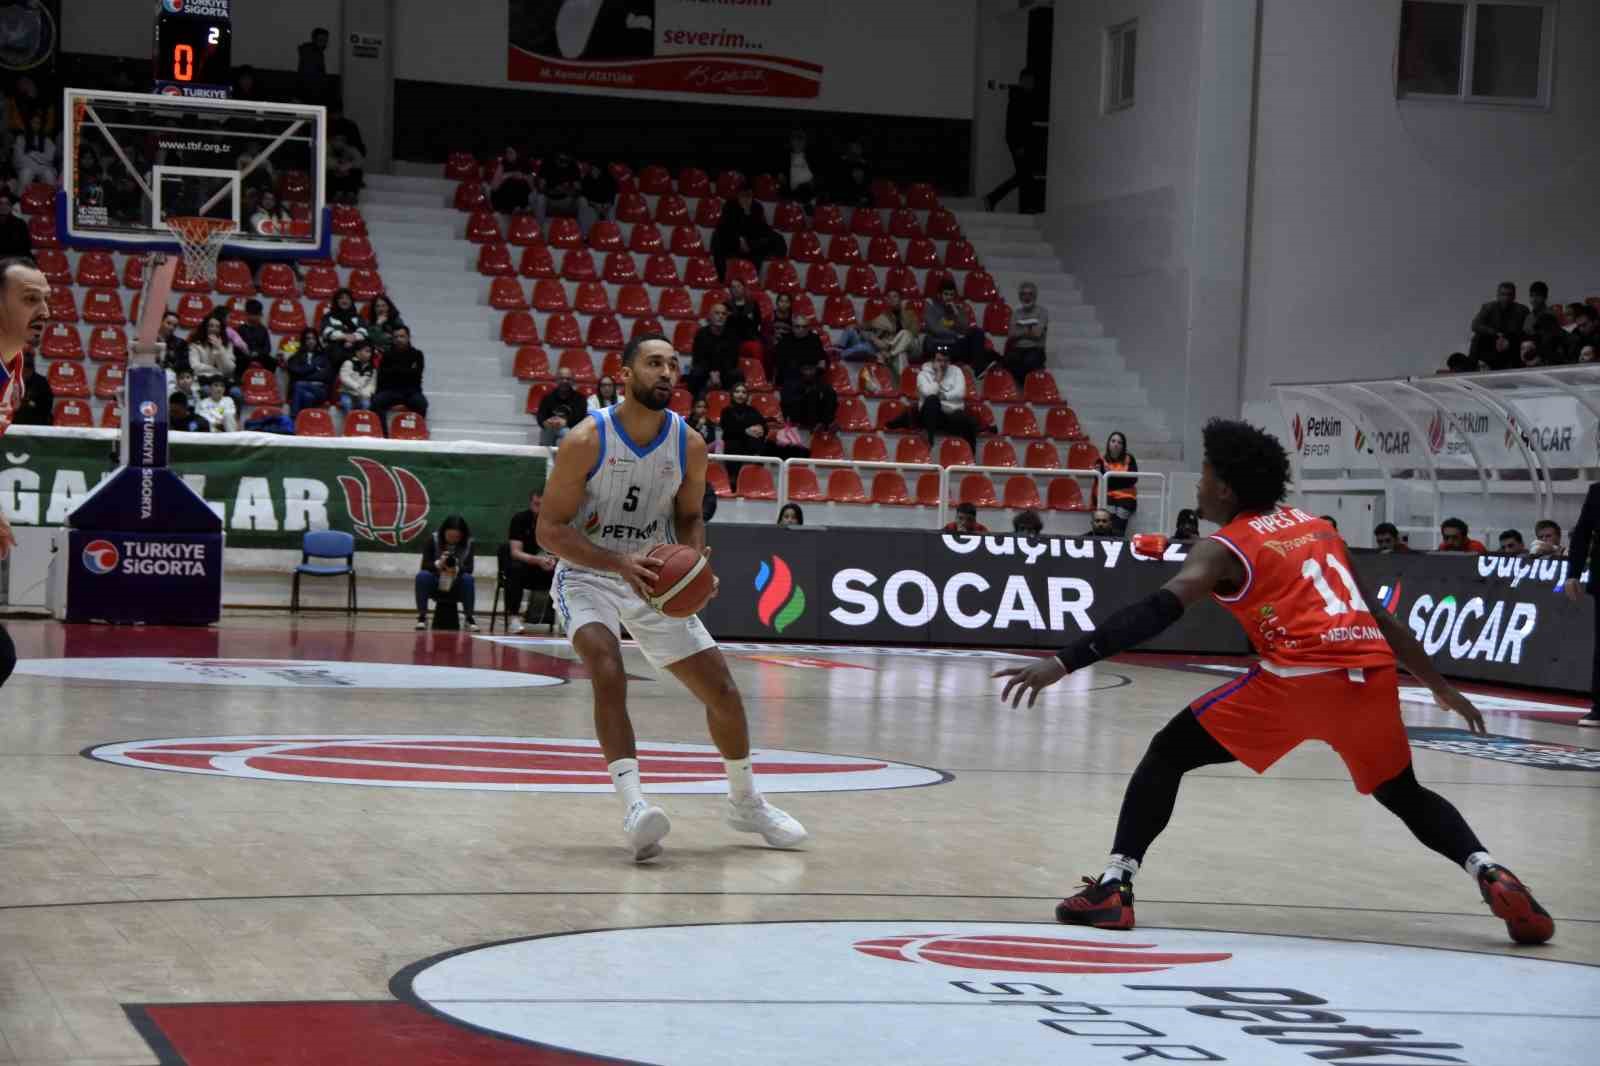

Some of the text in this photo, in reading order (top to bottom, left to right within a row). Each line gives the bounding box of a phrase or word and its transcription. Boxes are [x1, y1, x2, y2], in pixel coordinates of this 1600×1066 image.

[208, 27, 220, 44] 2
[174, 44, 193, 81] 0
[1307, 416, 1342, 437] Petkim
[1367, 431, 1411, 455] OCAR
[622, 485, 640, 512] 5
[1248, 511, 1296, 535] PIPES
[1301, 553, 1371, 617] 11
[829, 568, 1097, 632] SOCAR
[1408, 593, 1537, 665] SOCAR
